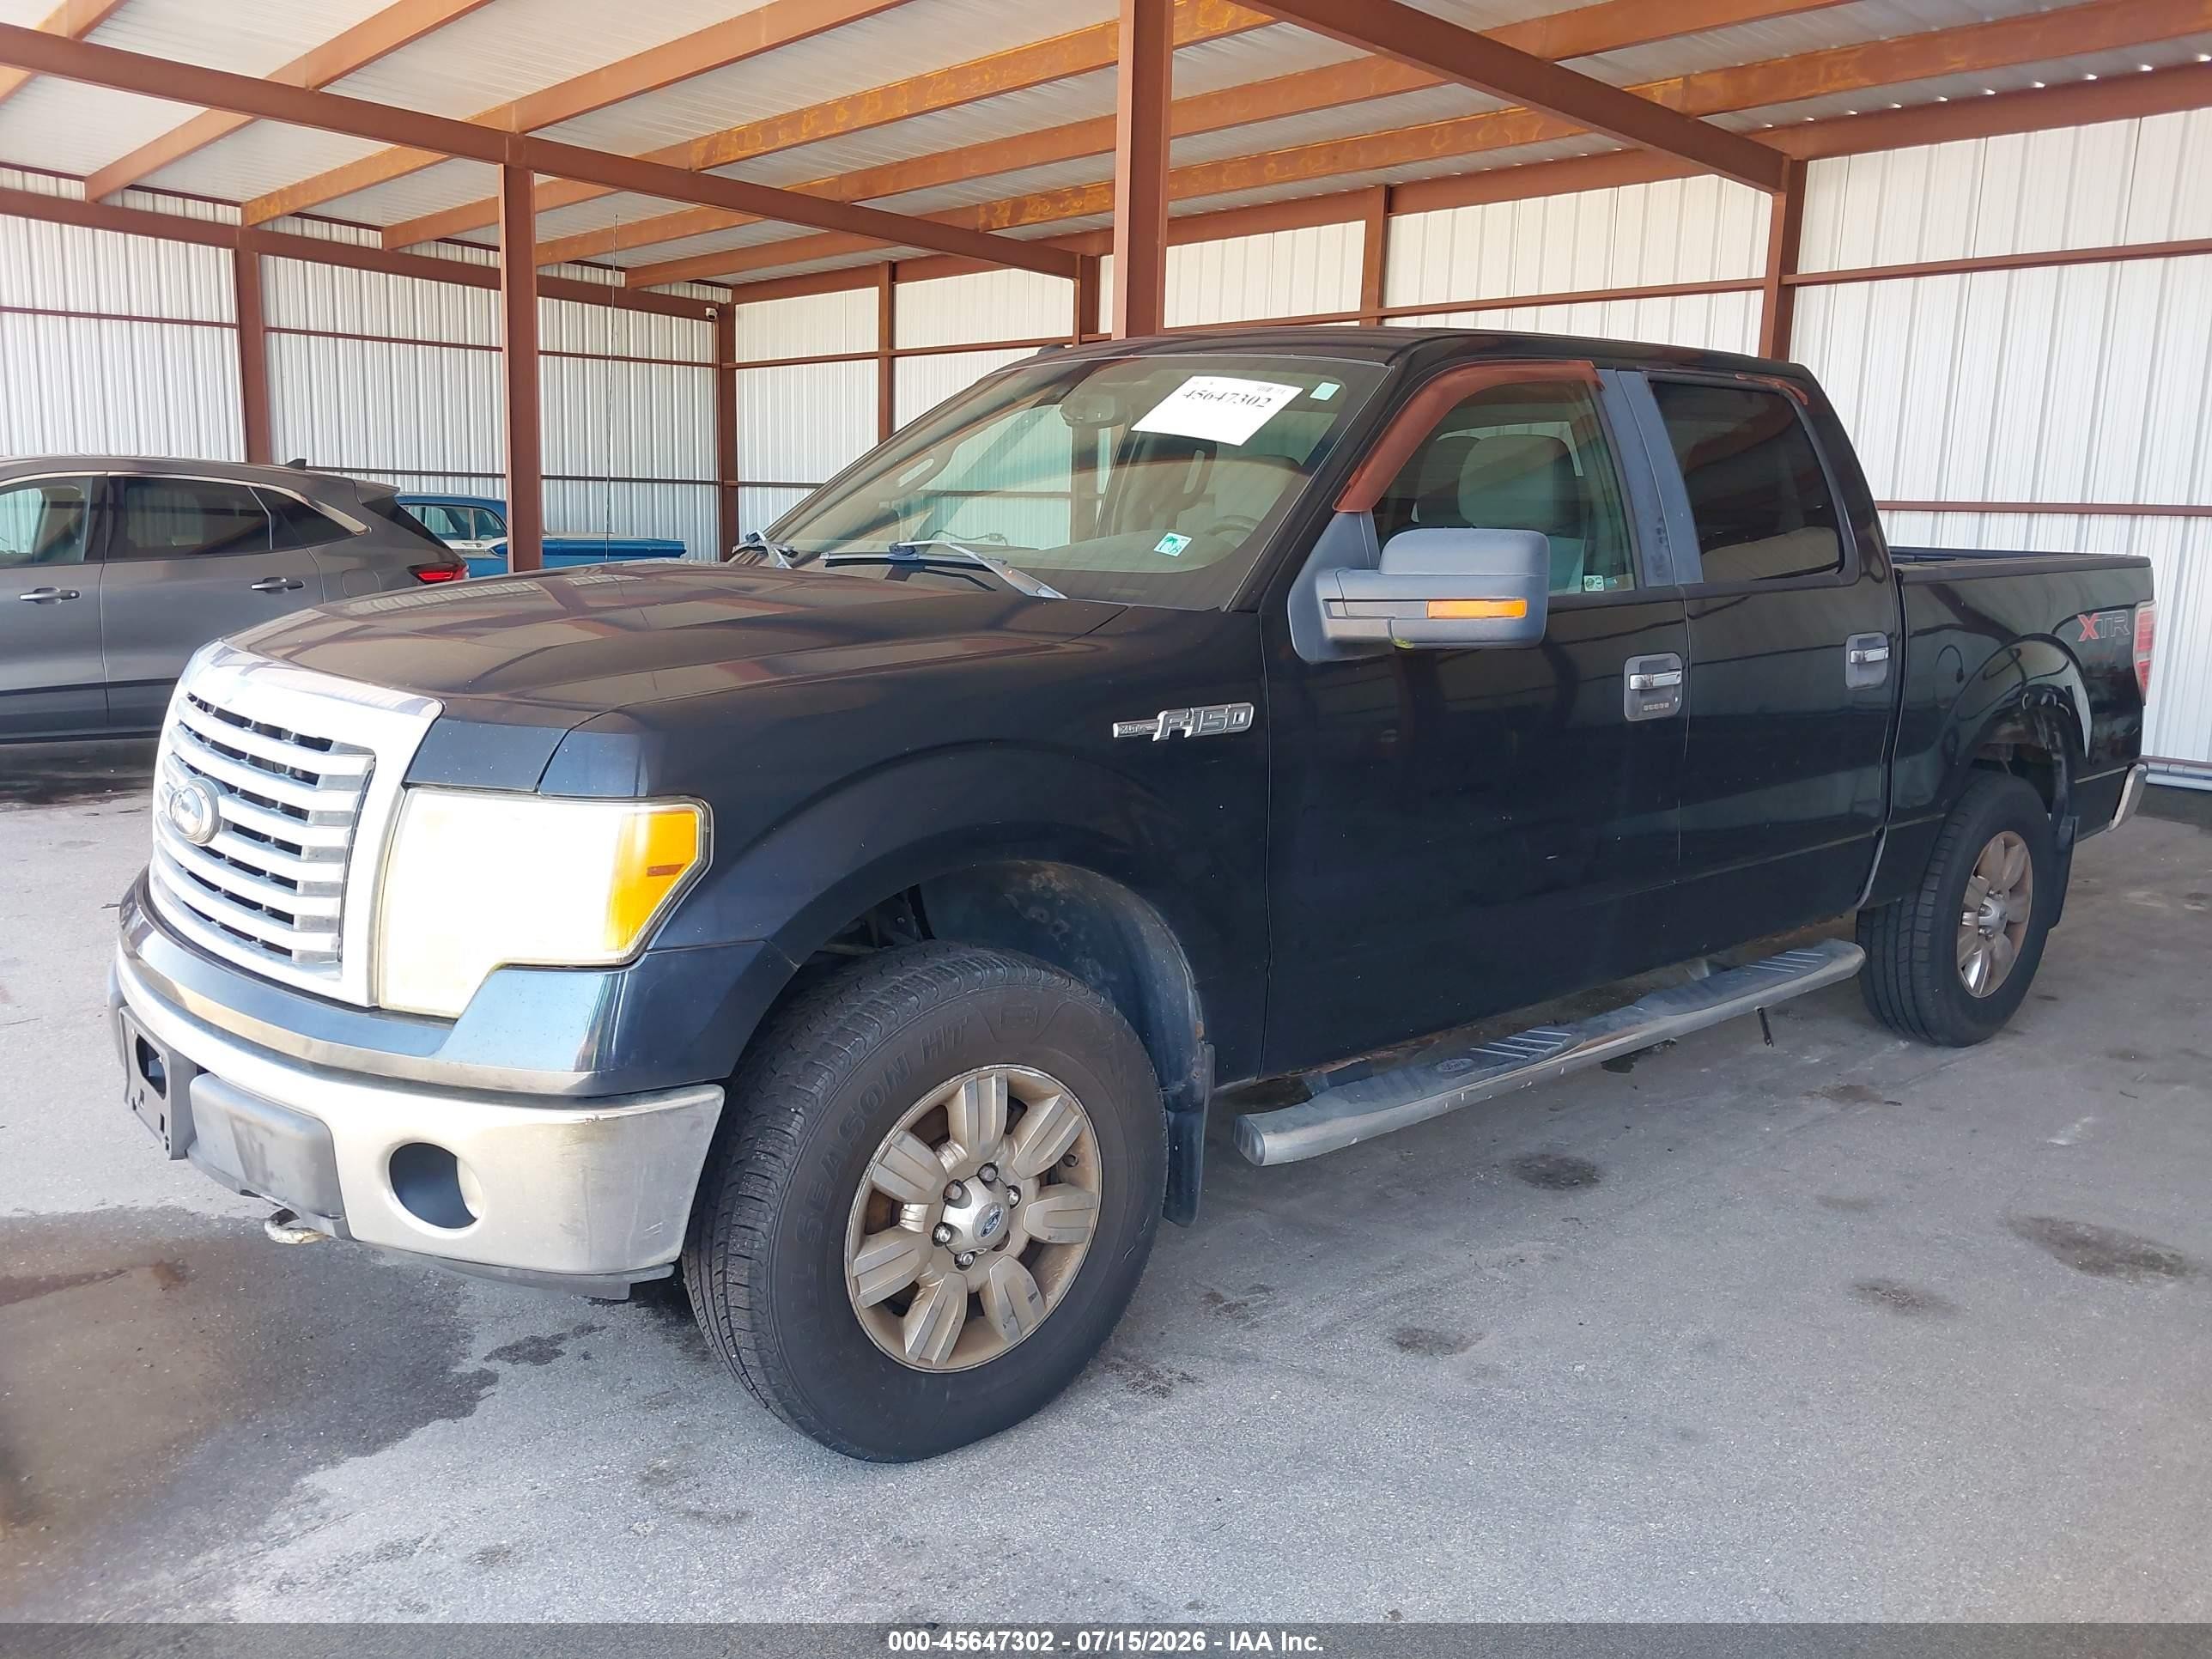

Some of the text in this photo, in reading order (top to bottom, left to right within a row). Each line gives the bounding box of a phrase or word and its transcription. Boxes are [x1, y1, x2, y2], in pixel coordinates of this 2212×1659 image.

[1182, 389, 1273, 408] 45647302
[2076, 610, 2130, 642] XTR
[796, 1052, 913, 1245] SEASON
